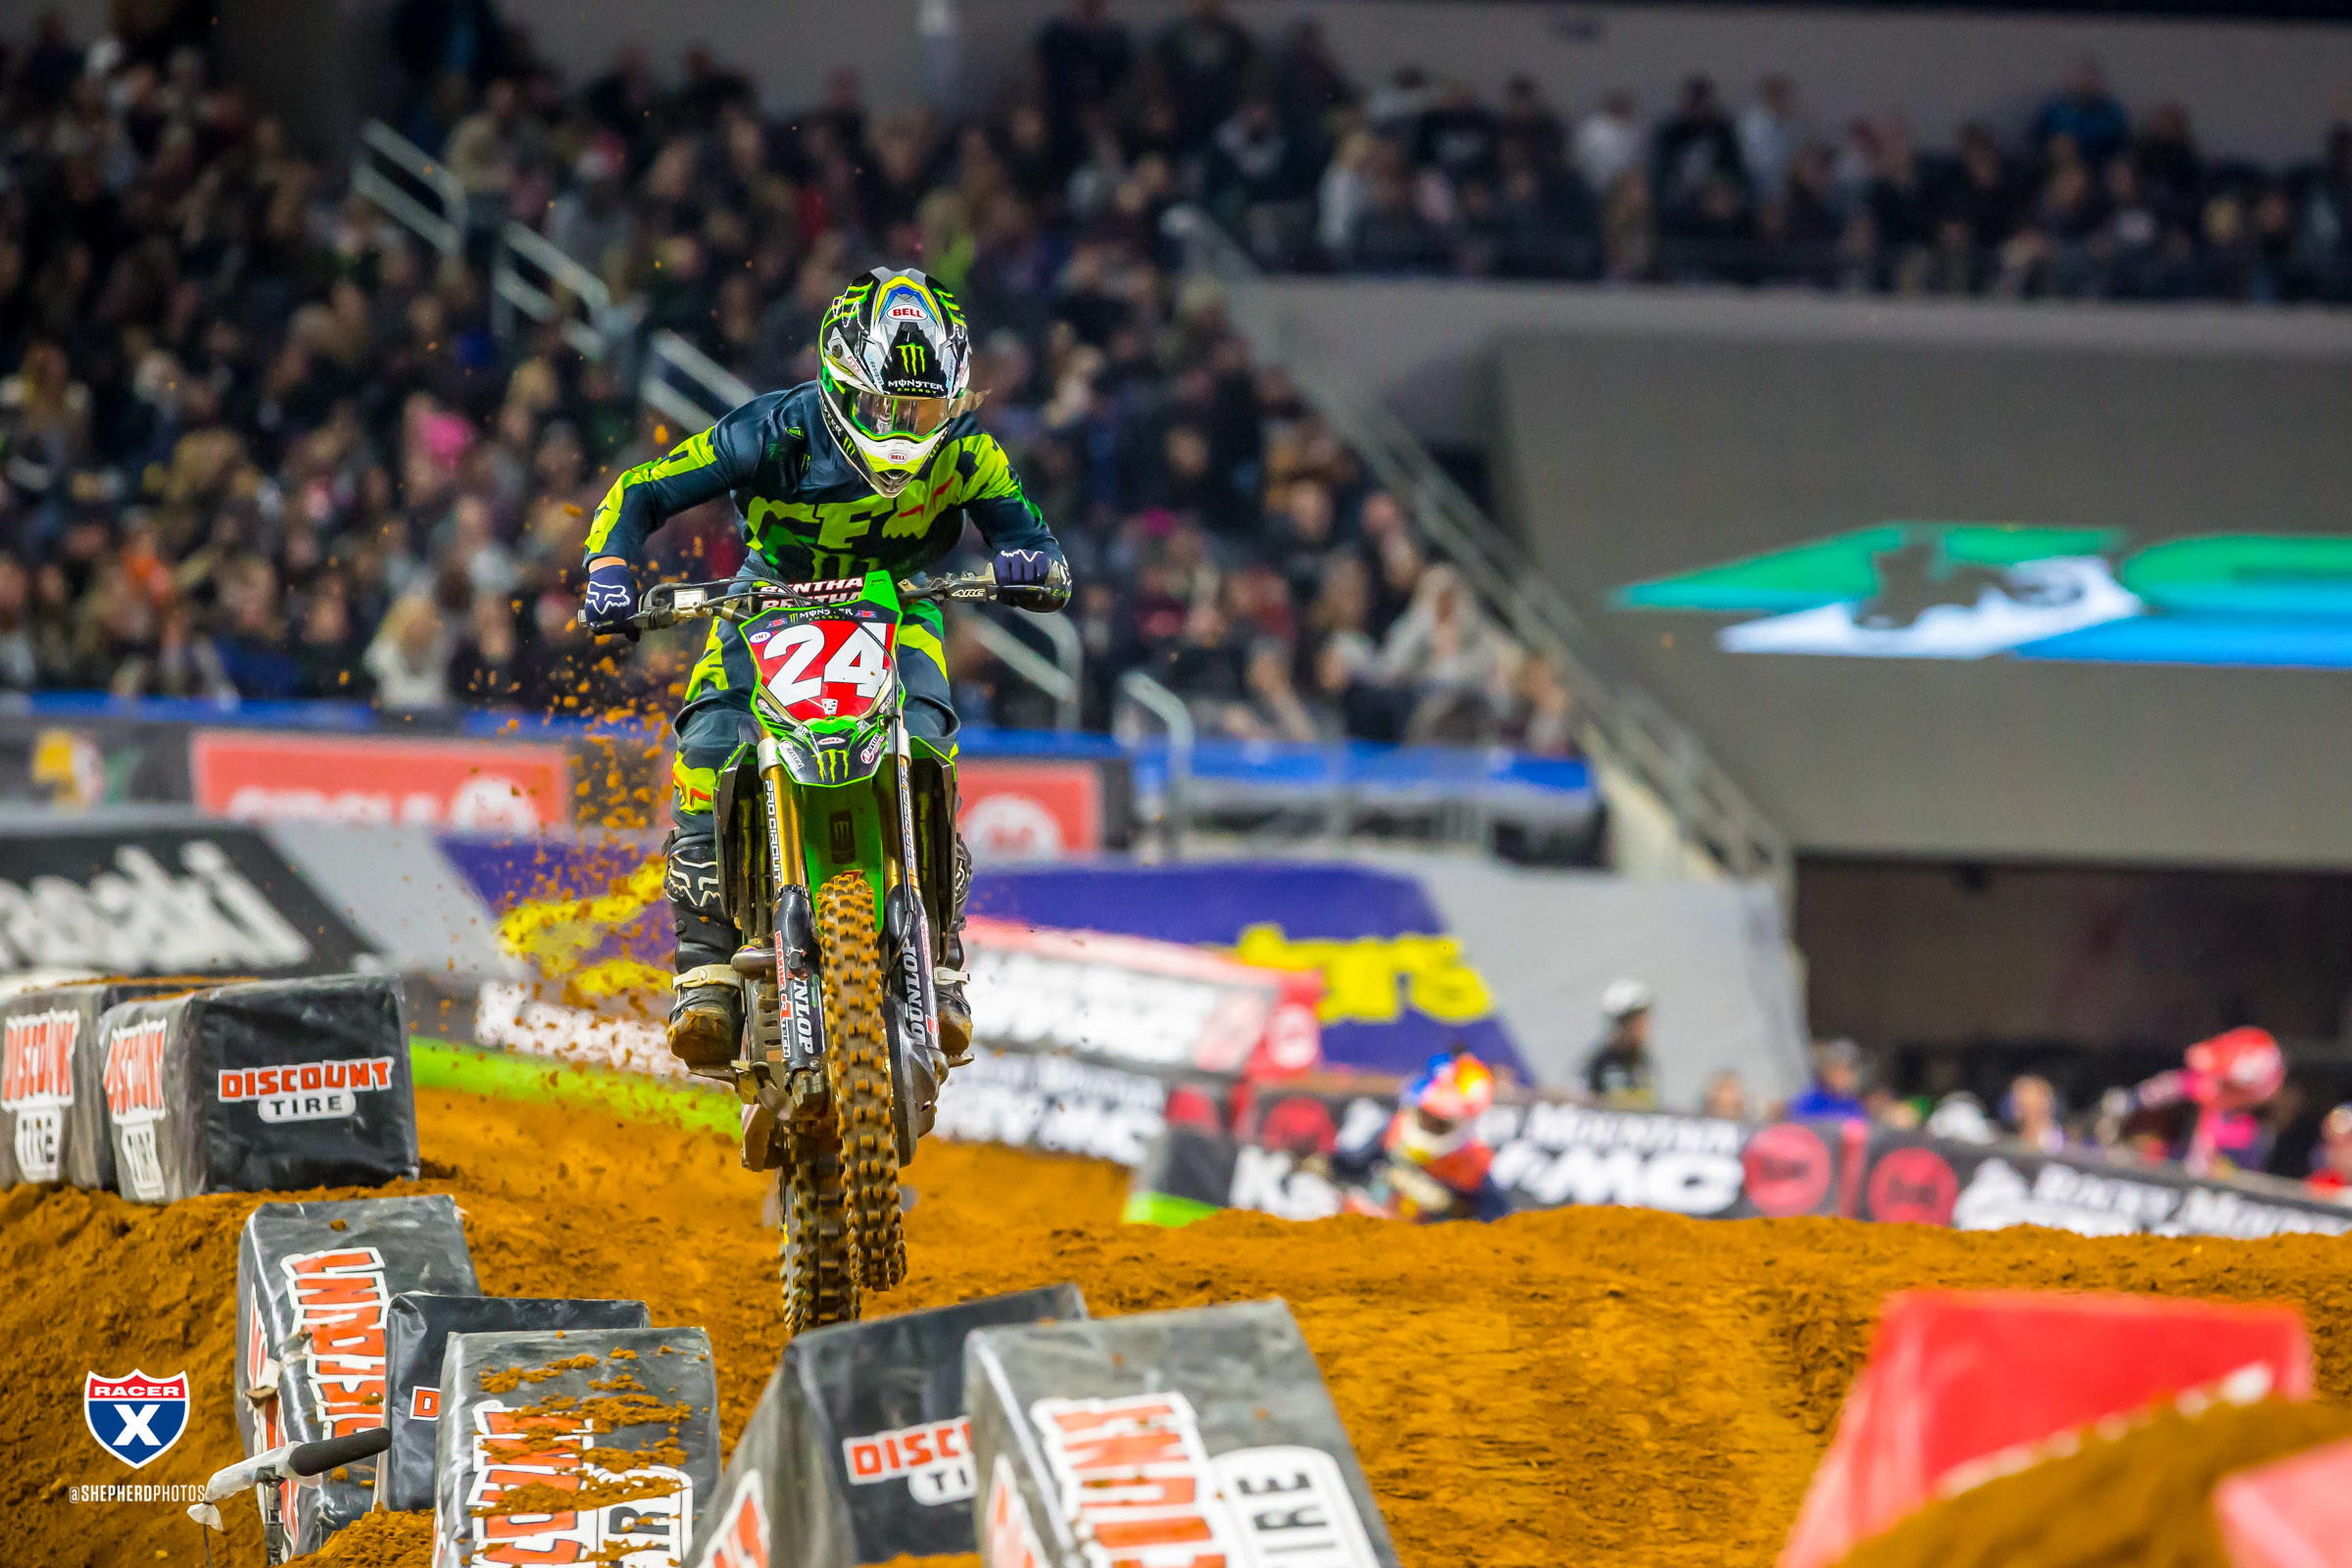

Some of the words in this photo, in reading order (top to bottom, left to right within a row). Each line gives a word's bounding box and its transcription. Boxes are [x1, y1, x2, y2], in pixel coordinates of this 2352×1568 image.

[893, 308, 923, 318] BELL
[888, 378, 945, 392] MONSTER
[760, 576, 864, 594] RENTHA
[800, 608, 855, 619] MONSR
[762, 621, 888, 708] 24
[765, 779, 776, 815] PRO
[768, 817, 782, 883] CIRCUIT
[794, 976, 814, 1055] NLOP
[220, 1059, 389, 1099] DISCOUNT
[269, 1095, 343, 1116] TIRE
[851, 1422, 972, 1476] DISC
[483, 1411, 586, 1566] COUNT
[927, 1469, 968, 1493] TI
[1237, 1472, 1340, 1568] IRE
